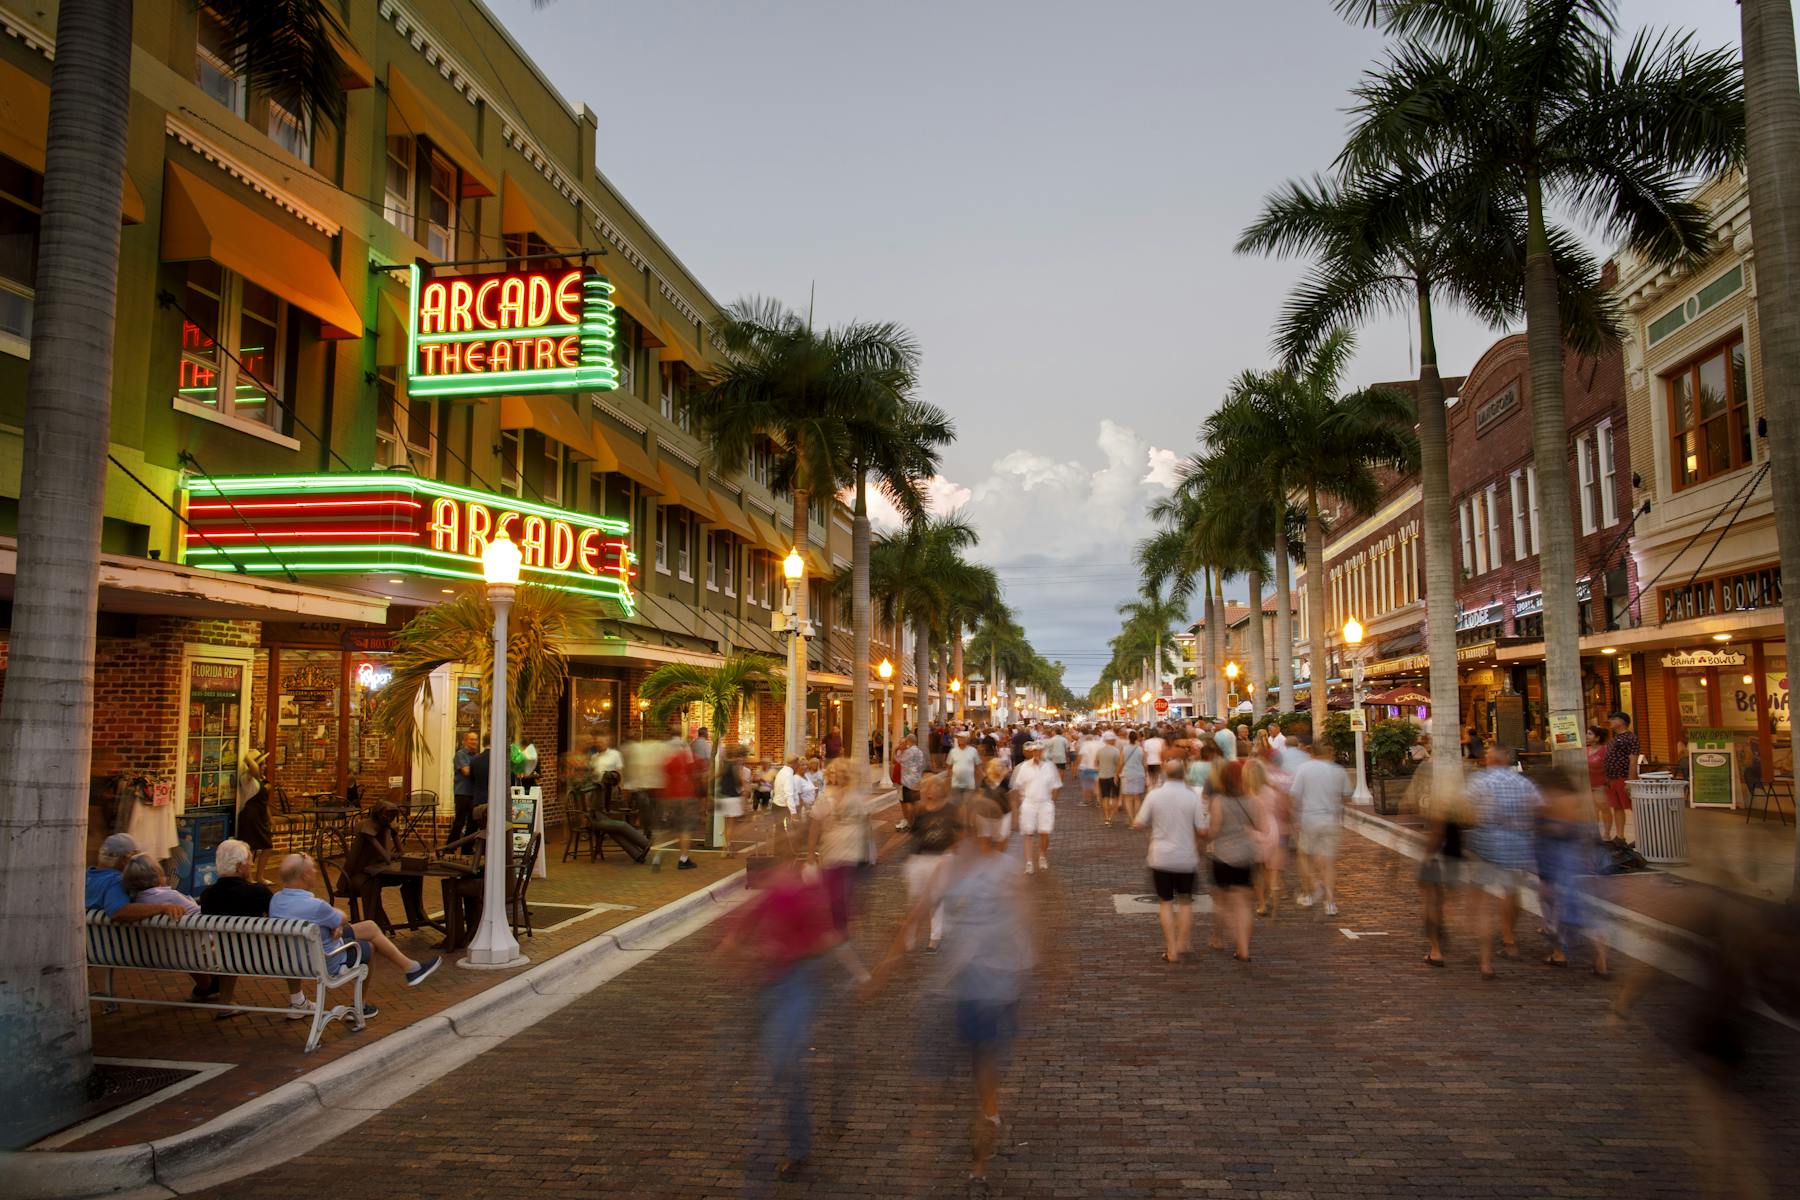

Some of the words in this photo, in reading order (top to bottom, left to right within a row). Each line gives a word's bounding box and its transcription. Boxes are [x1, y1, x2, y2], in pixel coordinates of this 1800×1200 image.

[420, 271, 582, 334] ARCADE
[420, 335, 580, 376] THEATRE
[1665, 588, 1717, 620] BAHIA
[192, 664, 222, 678] FLORIDA
[224, 667, 238, 679] REP
